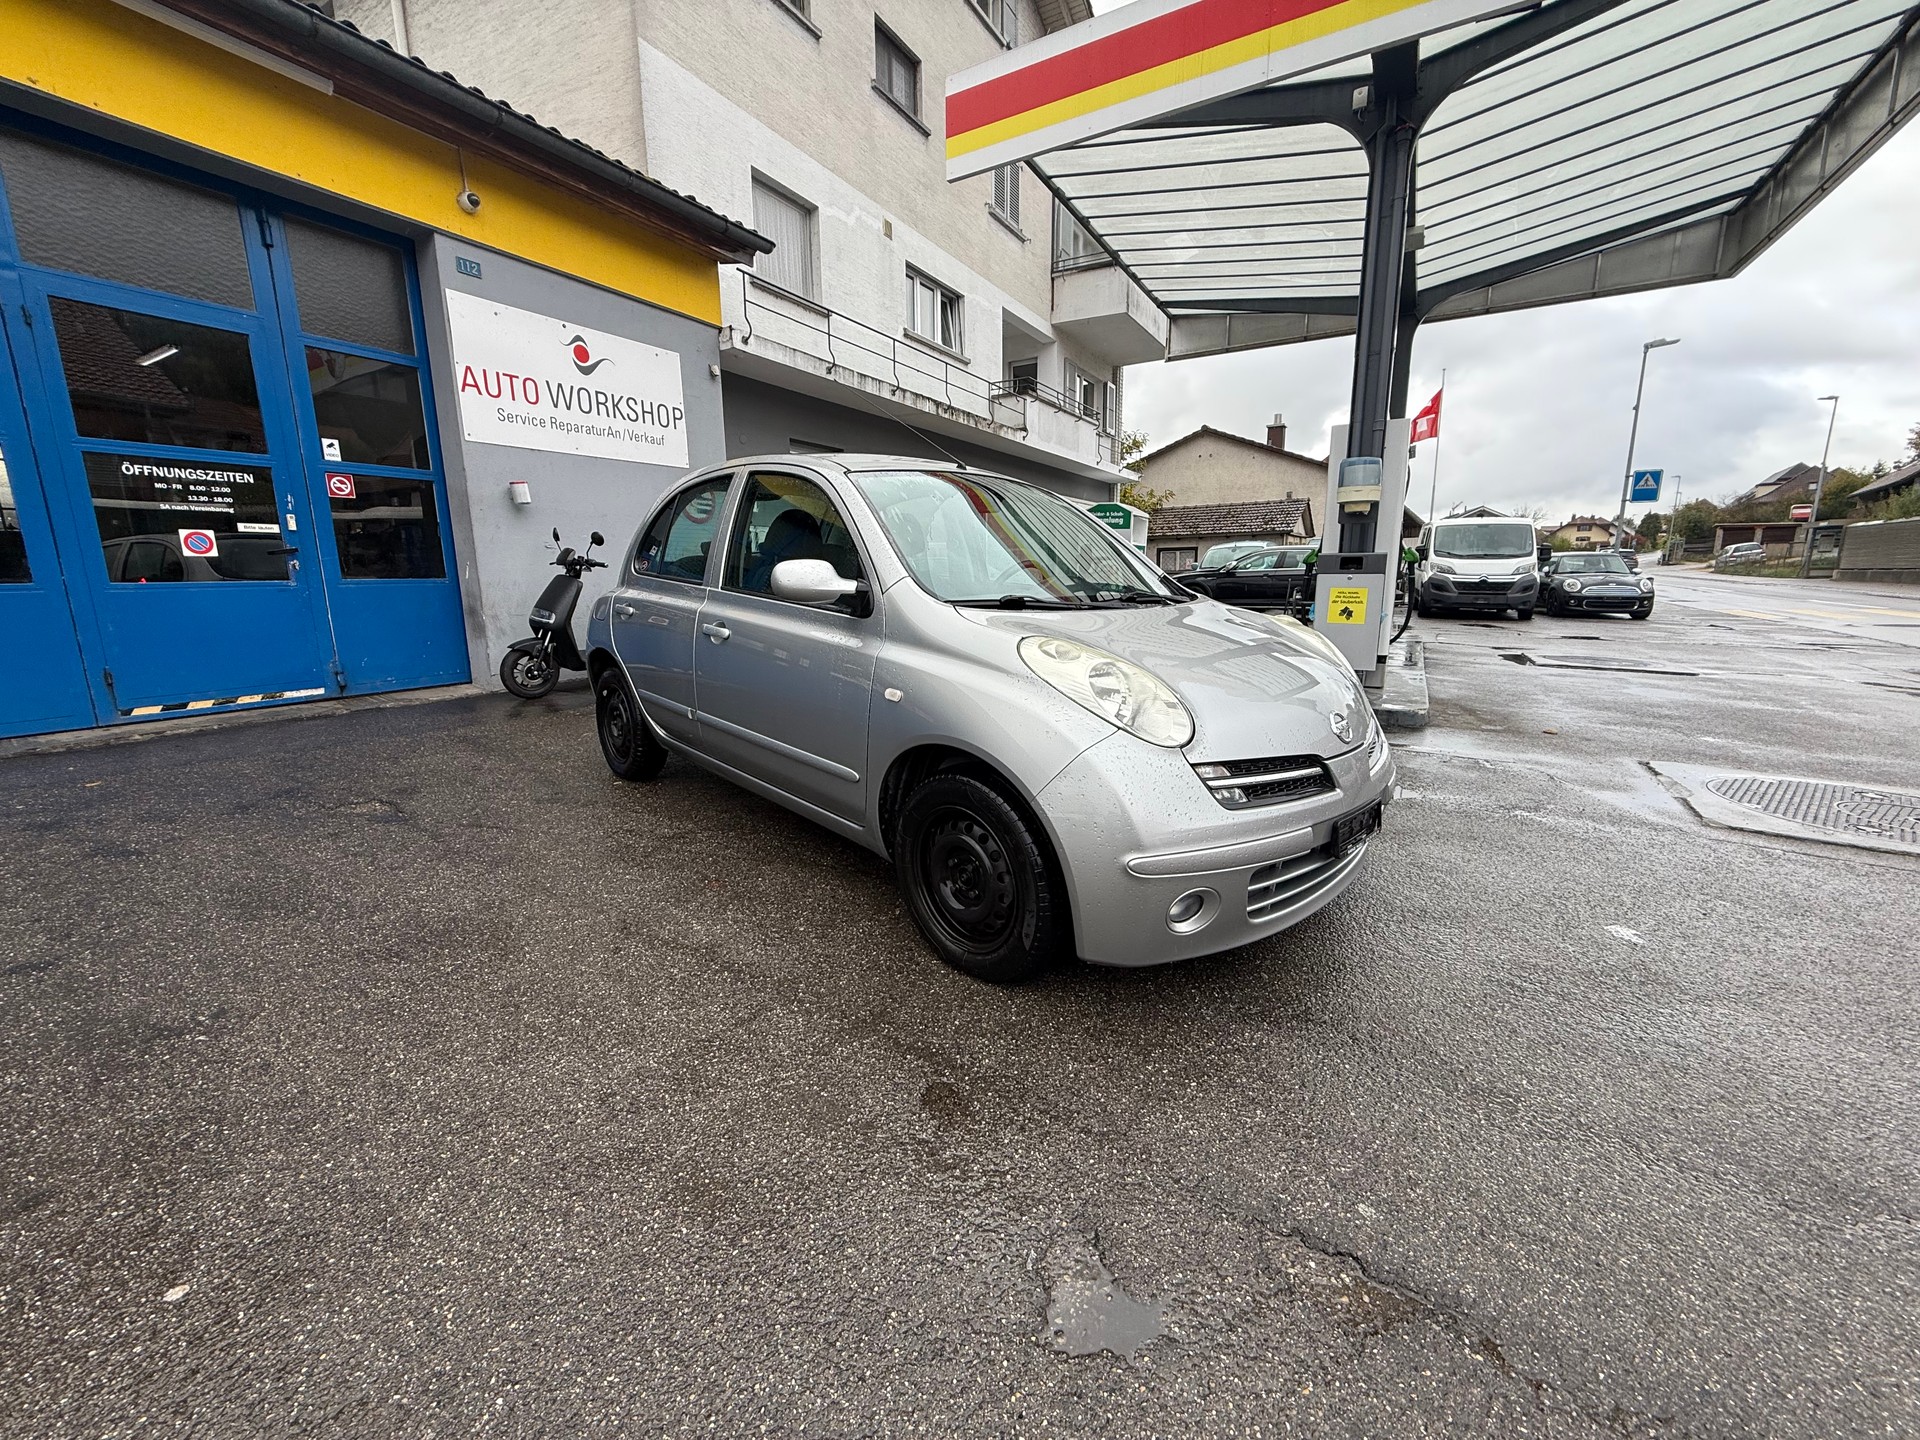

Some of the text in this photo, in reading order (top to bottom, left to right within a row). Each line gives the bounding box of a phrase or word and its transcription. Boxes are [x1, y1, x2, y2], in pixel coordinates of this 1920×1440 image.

[459, 258, 478, 275] 112
[461, 365, 684, 430] AUTO WORKSHOP
[496, 407, 546, 428] Service
[121, 461, 255, 484] ÖFFNUNGSZEITEN
[189, 505, 235, 514] Vereinbarung
